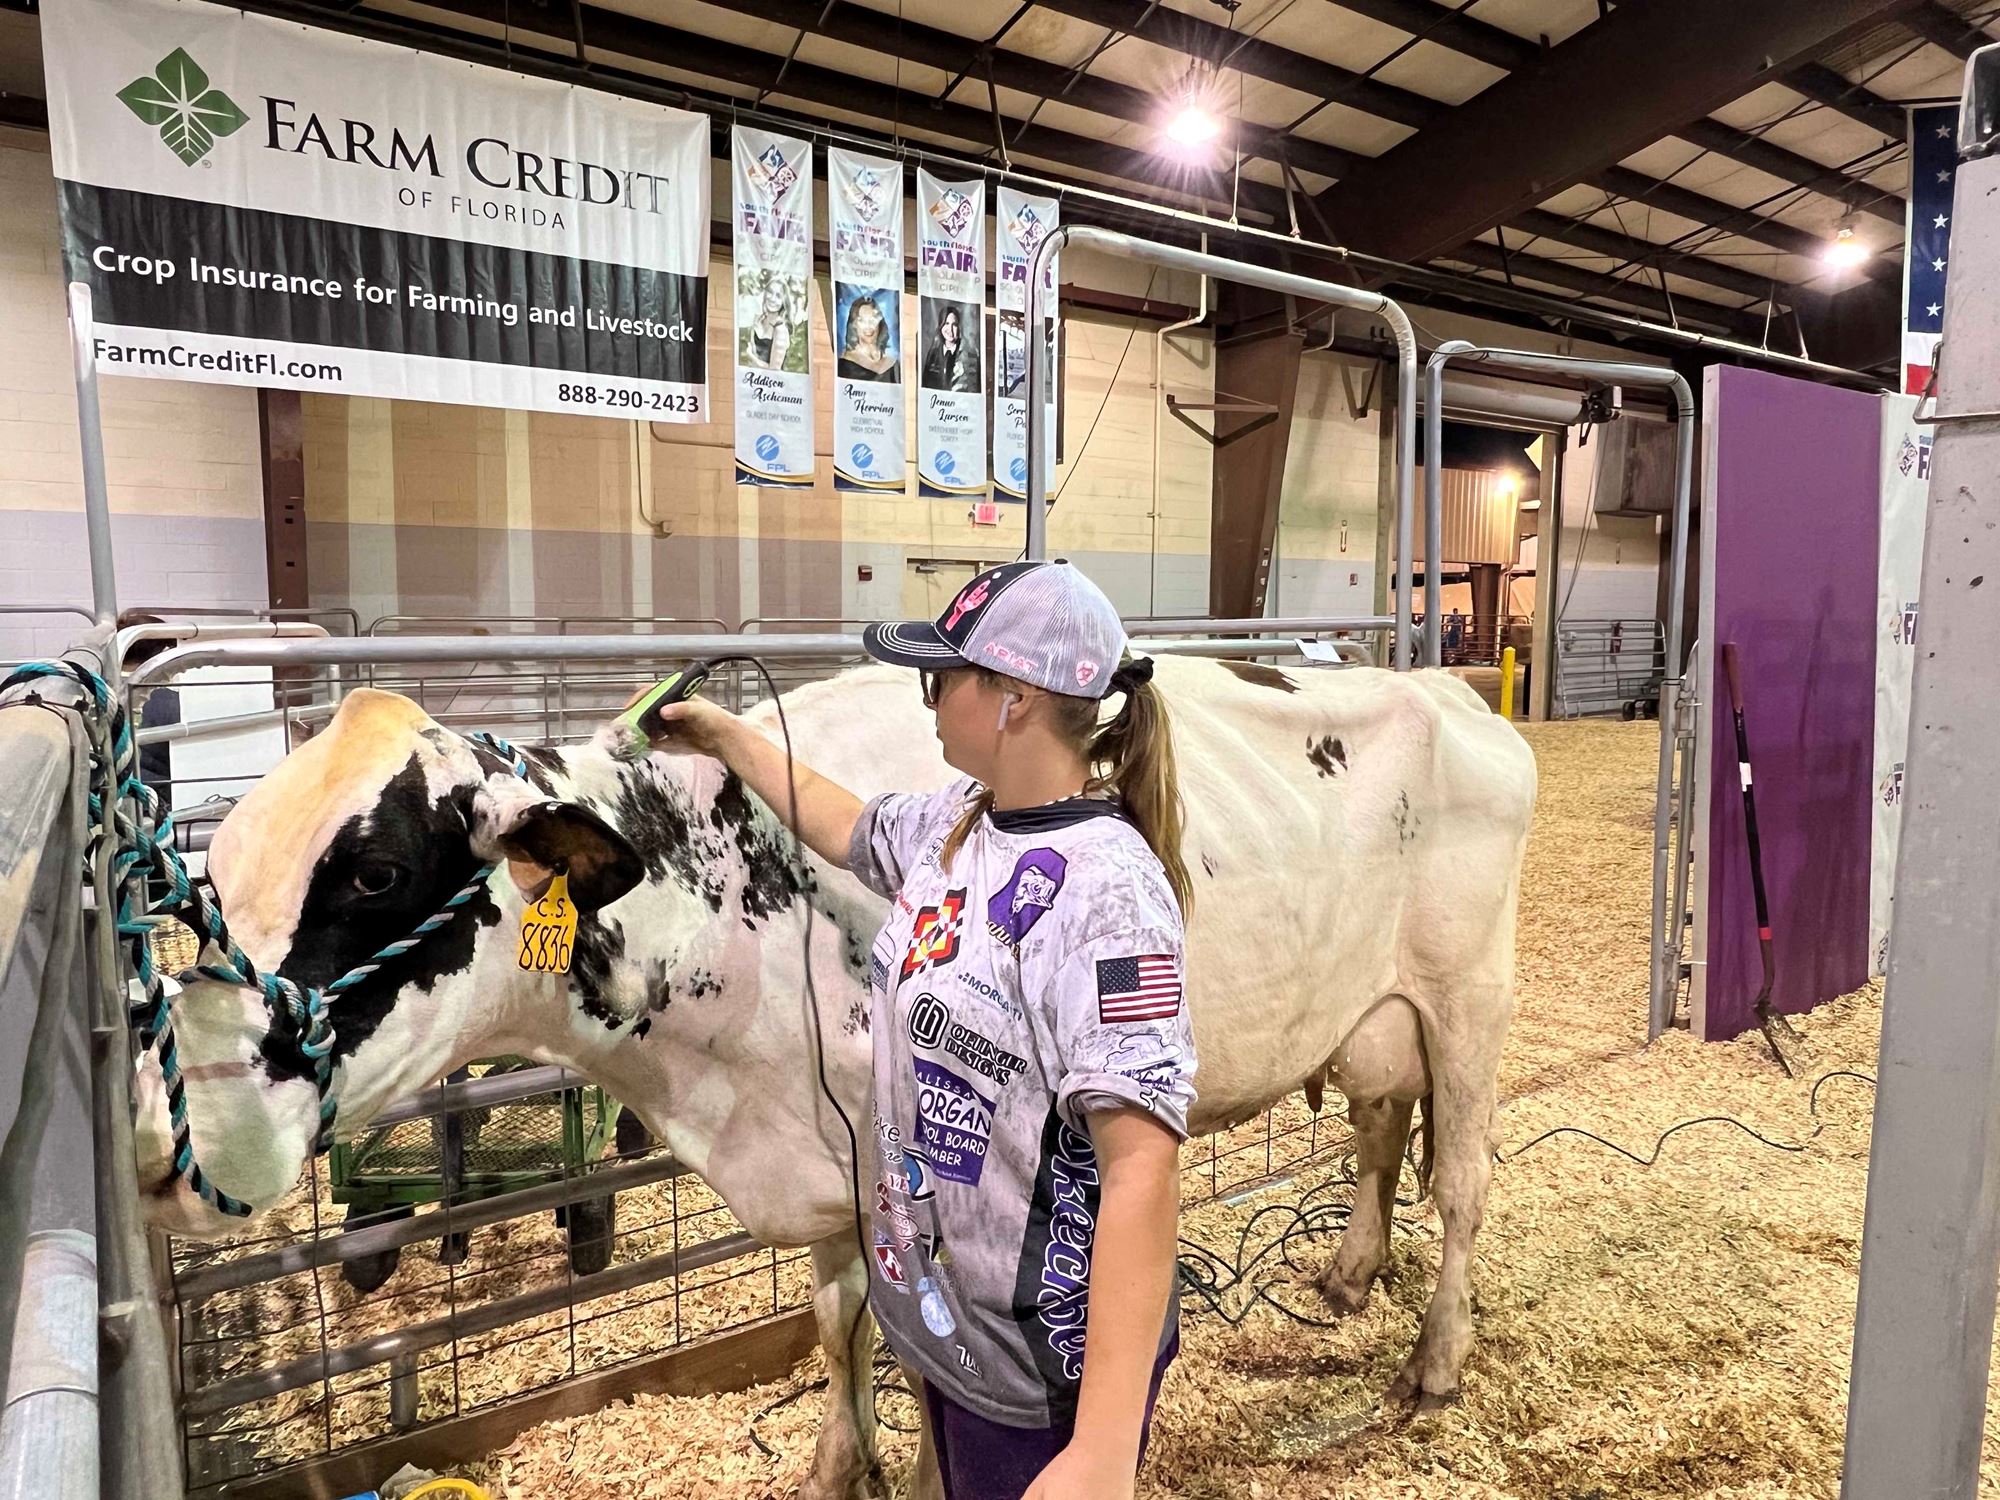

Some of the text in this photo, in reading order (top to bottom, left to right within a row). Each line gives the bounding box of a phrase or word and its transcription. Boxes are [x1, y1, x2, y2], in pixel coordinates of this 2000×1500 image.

[259, 95, 669, 215] FARM CREDIT
[398, 187, 565, 230] OF FLORIDA
[922, 247, 978, 274] FAIR
[92, 246, 694, 343] Crop Insurance for Farming and Livestock
[93, 338, 342, 382] FarmCreditFl.com
[558, 383, 699, 413] 888-290-2423
[843, 384, 867, 400] Amy
[767, 463, 791, 472] FPL
[862, 470, 885, 479] FPL
[983, 641, 1039, 673] ARIAT
[519, 922, 570, 971] 8836
[920, 1089, 992, 1136] ORGAN
[929, 1147, 962, 1166] MBER
[945, 1132, 986, 1156] BOARD
